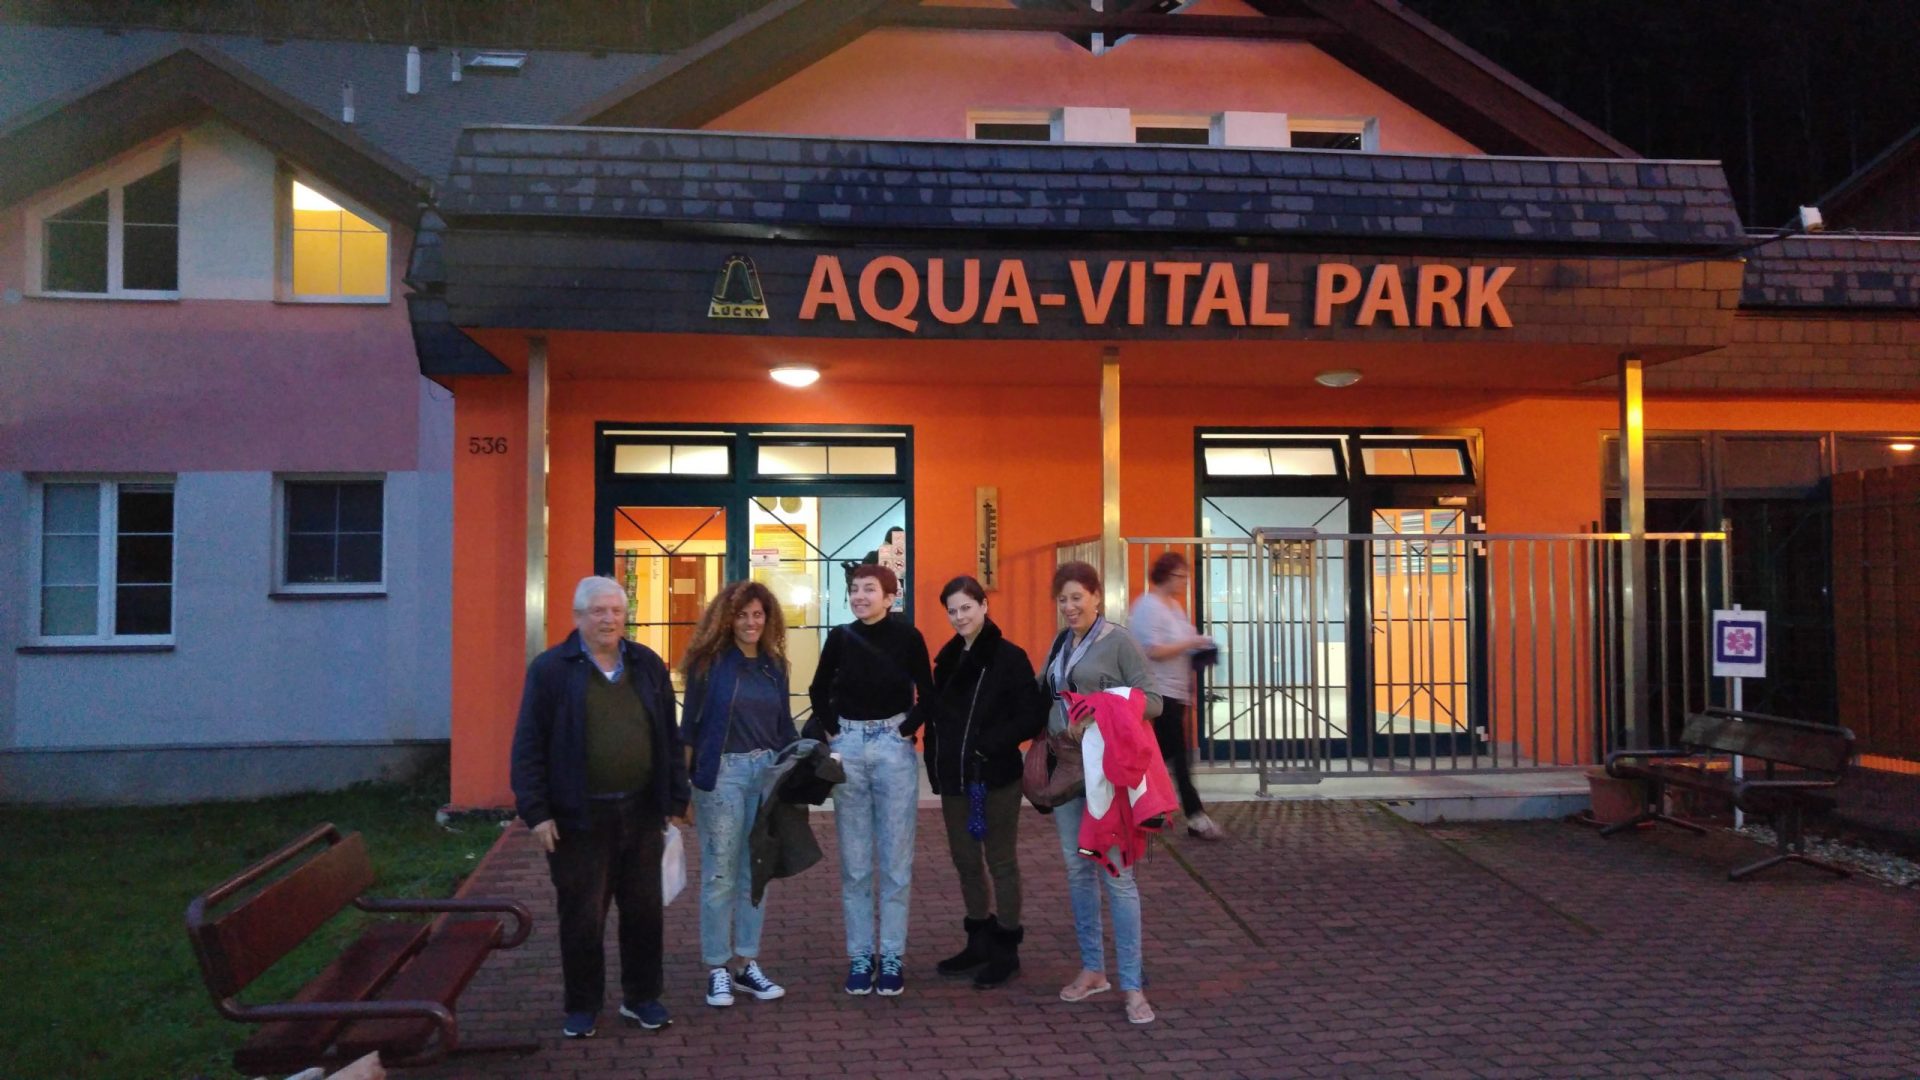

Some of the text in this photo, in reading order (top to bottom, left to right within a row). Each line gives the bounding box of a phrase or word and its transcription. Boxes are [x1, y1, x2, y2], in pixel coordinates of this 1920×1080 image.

[798, 254, 1517, 333] AQUA-VITAL PARK
[469, 436, 507, 454] 536
